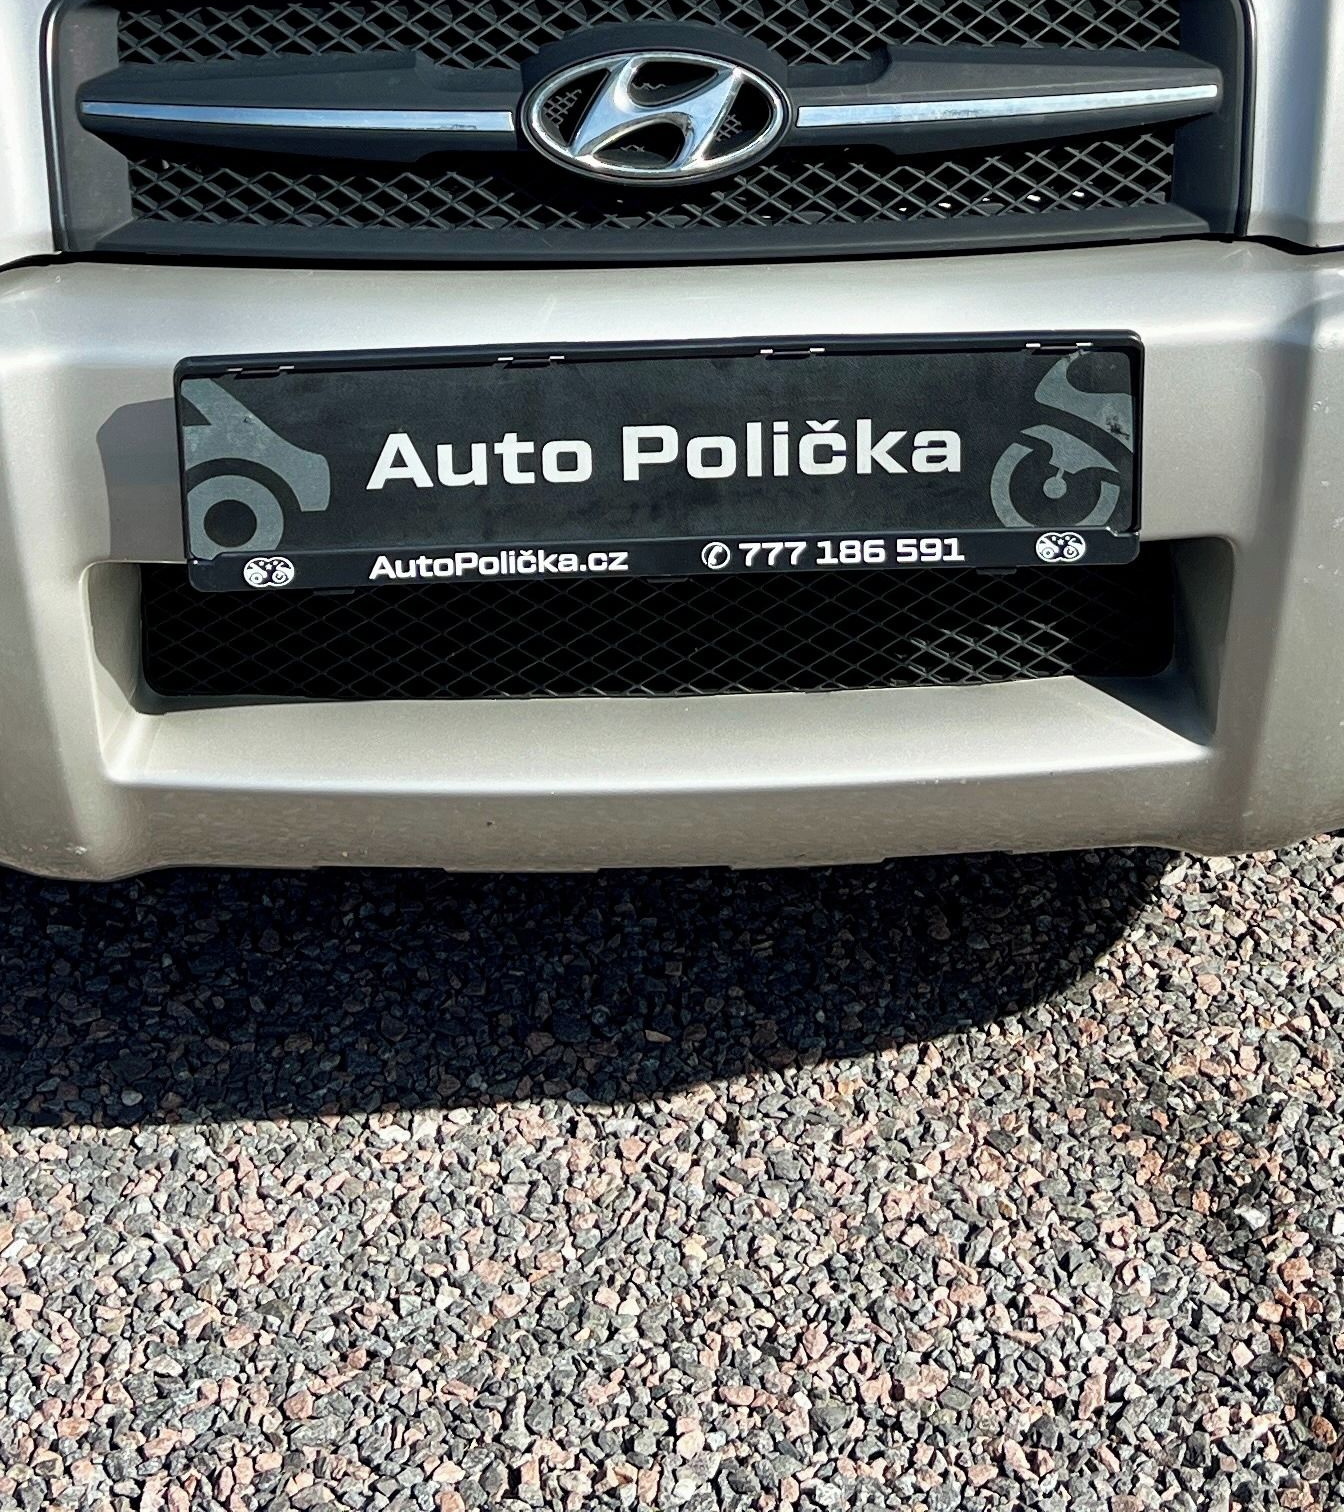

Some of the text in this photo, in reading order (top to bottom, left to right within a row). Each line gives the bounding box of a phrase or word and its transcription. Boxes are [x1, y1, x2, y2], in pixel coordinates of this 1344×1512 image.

[365, 418, 962, 490] Auto Polička
[368, 549, 629, 580] AutoPolička.cz
[738, 537, 966, 567] 777 186 591
